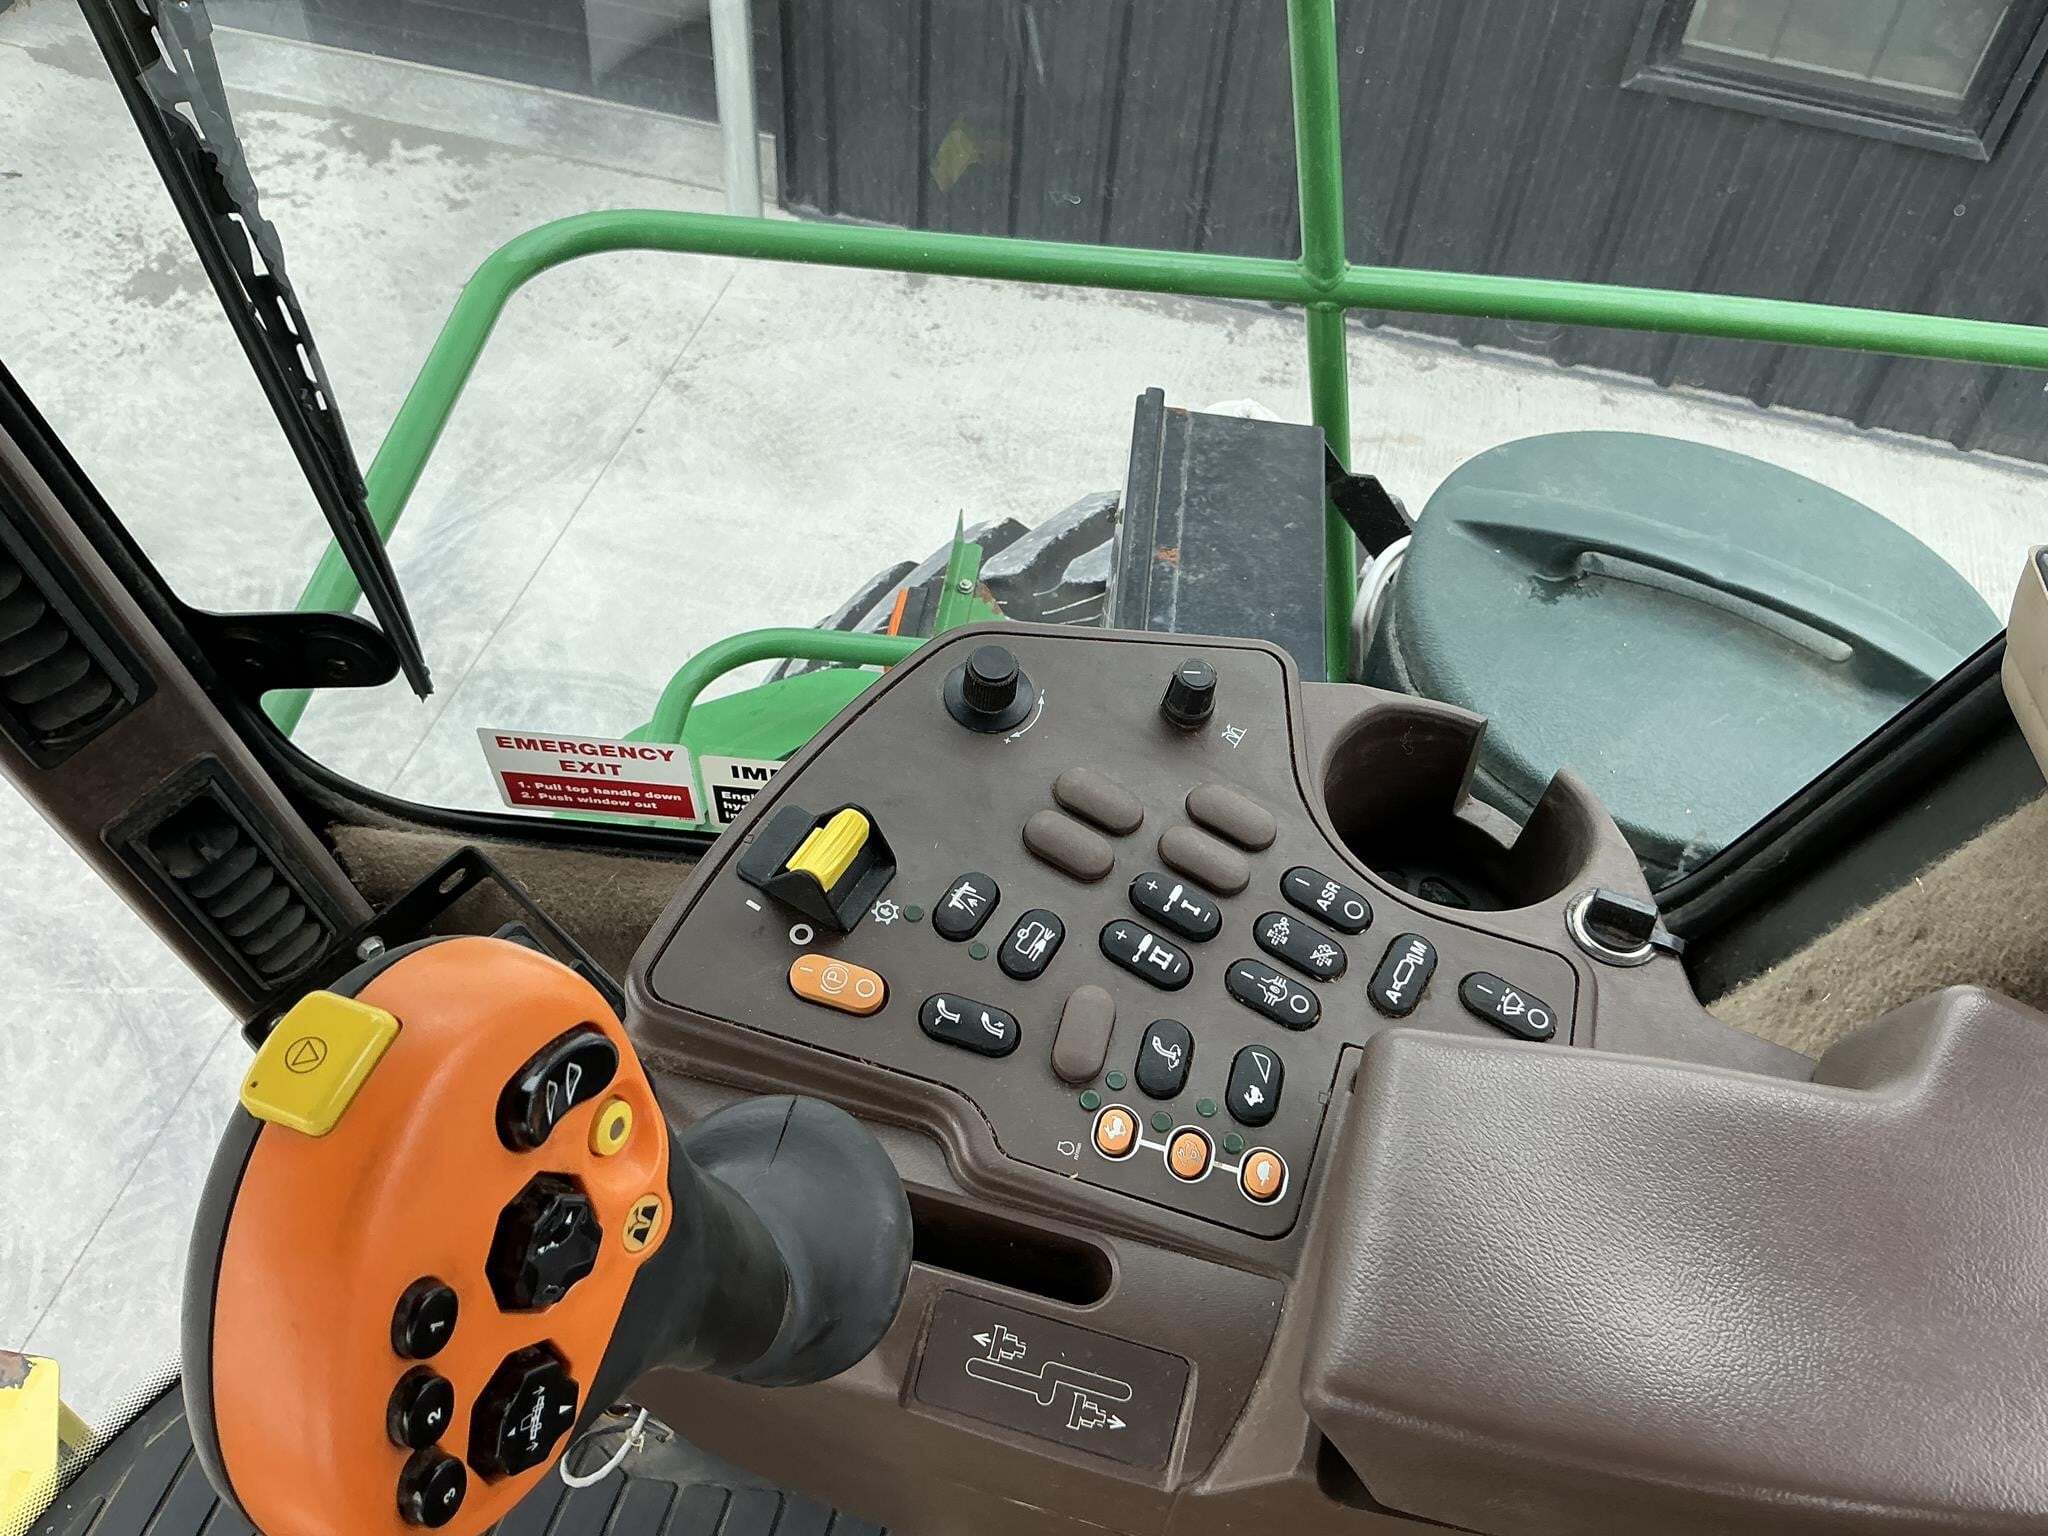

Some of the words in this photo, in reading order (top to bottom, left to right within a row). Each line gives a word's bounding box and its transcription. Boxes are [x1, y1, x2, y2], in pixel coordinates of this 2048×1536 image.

[495, 735, 675, 762] EMERGENCY
[559, 760, 622, 776] EXIT
[518, 781, 531, 789] 1.
[534, 781, 562, 792] Pull
[565, 784, 590, 795] top
[593, 786, 641, 798] handle
[644, 791, 682, 802] down
[521, 791, 535, 799] 2.
[538, 791, 573, 803] Push
[577, 795, 630, 807] window
[634, 801, 658, 809] out
[1316, 881, 1341, 912] ASR
[1385, 989, 1402, 1005] A
[430, 1321, 445, 1333] 1
[427, 1407, 442, 1425] 2
[443, 1487, 456, 1504] 3
